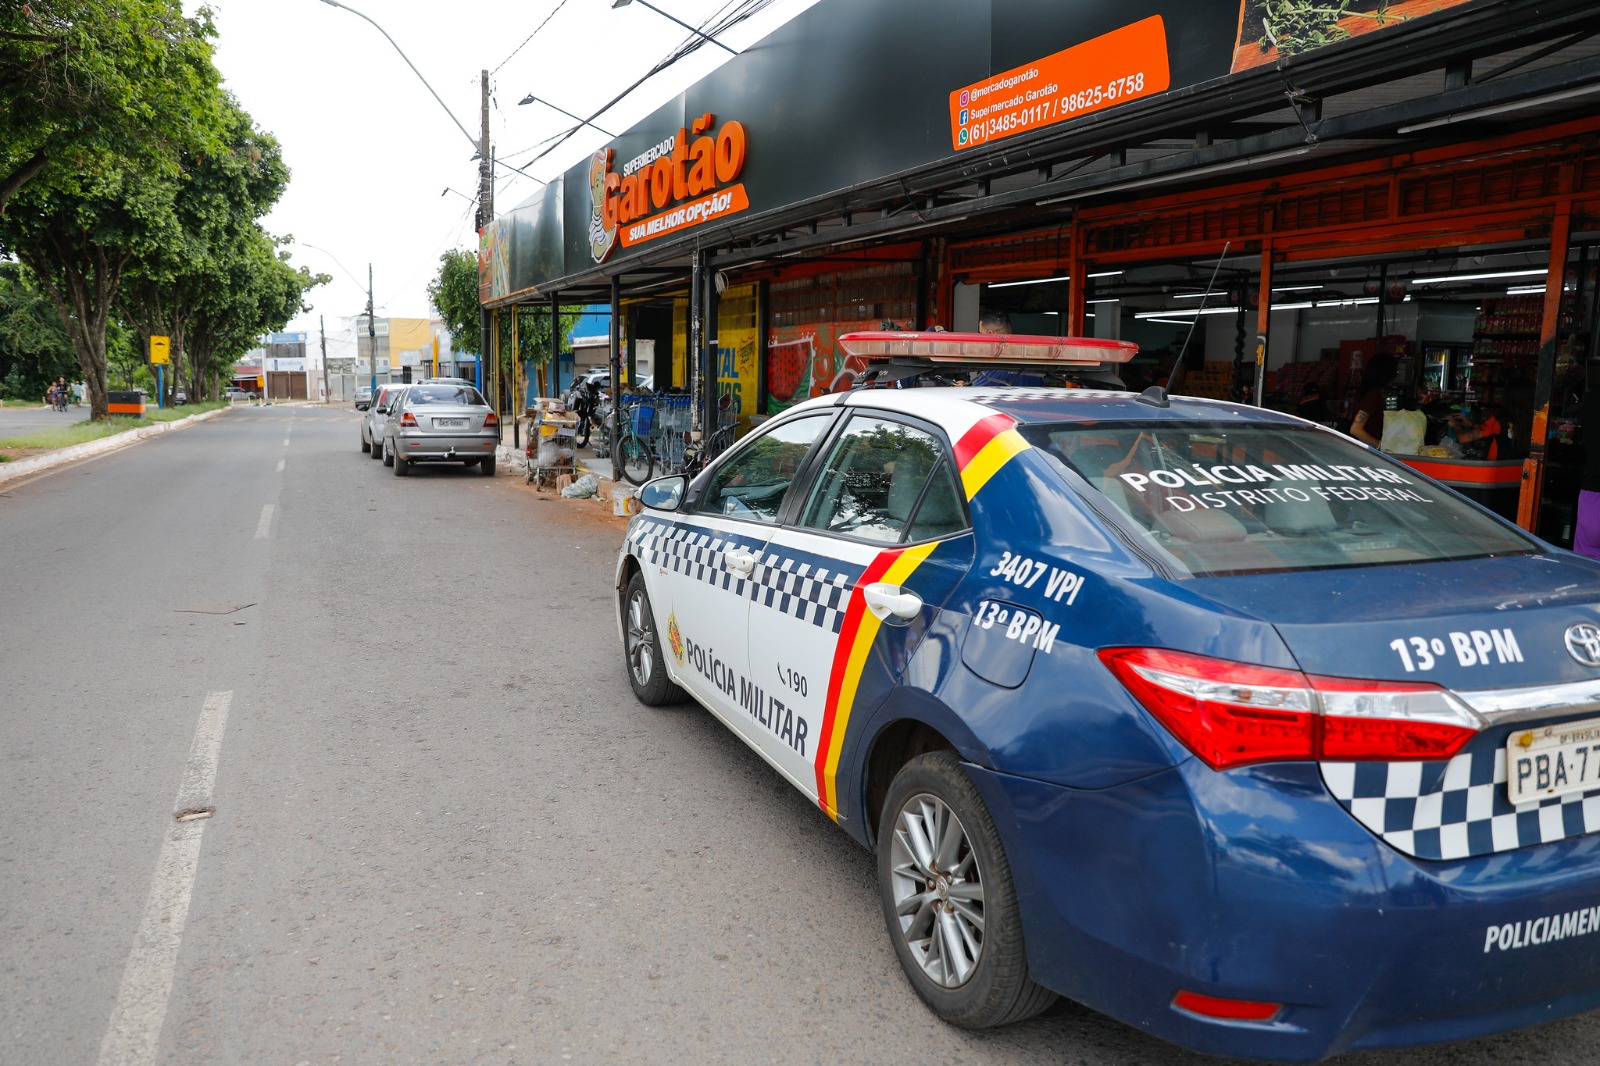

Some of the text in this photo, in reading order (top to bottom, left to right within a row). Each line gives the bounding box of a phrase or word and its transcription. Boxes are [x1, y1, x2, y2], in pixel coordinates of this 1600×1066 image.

[970, 83, 1058, 120] Supermercado Garotão
[971, 68, 1039, 101] @mercadogarotão
[969, 102, 1050, 144] (61)3485-0117
[1061, 72, 1145, 115] 98625-6758
[602, 113, 745, 232] Garotão
[623, 136, 675, 177] SUPERMERCADO
[629, 192, 732, 241] SUA MELHOR OPÇÃO!
[1120, 463, 1414, 492] POLÍCIA MILITAR
[1166, 486, 1433, 513] DISTRITO FEDERAL
[990, 551, 1085, 606] 3407 VPI
[1006, 610, 1061, 654] BPM
[1449, 628, 1525, 667] BPM
[686, 637, 736, 701] POLÍCIA
[740, 675, 808, 757] MILITAR
[787, 668, 808, 697] 190
[1484, 905, 1600, 953] POLICIAMEN
